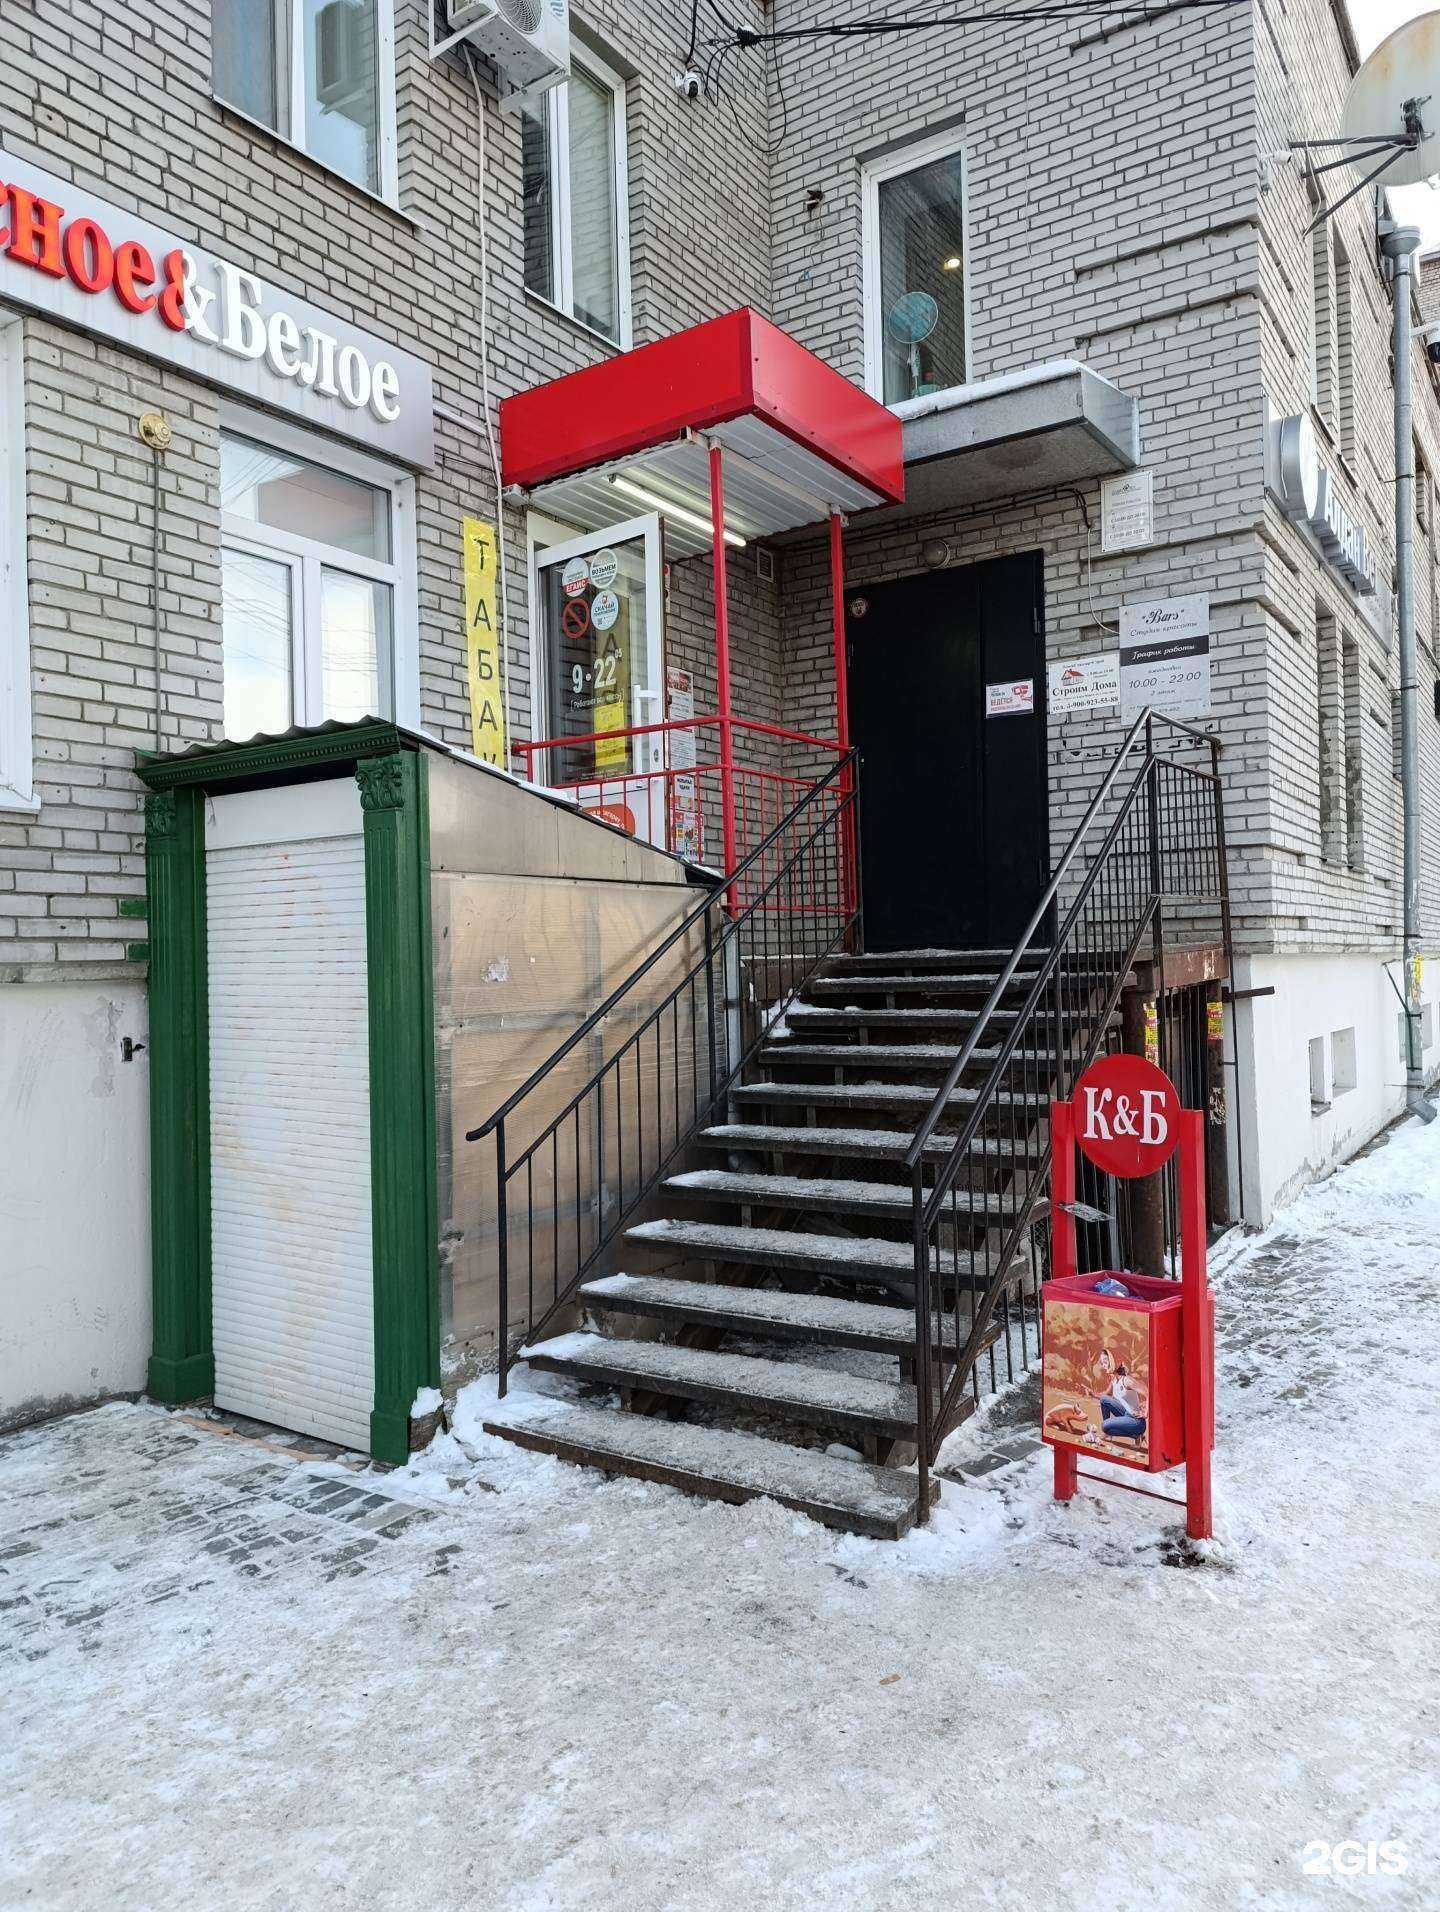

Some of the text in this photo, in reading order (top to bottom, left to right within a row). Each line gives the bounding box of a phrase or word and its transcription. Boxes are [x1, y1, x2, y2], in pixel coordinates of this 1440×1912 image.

[1052, 685, 1088, 696] Строим
[1090, 681, 1117, 692] Дома
[1083, 1087, 1168, 1144] К&Б
